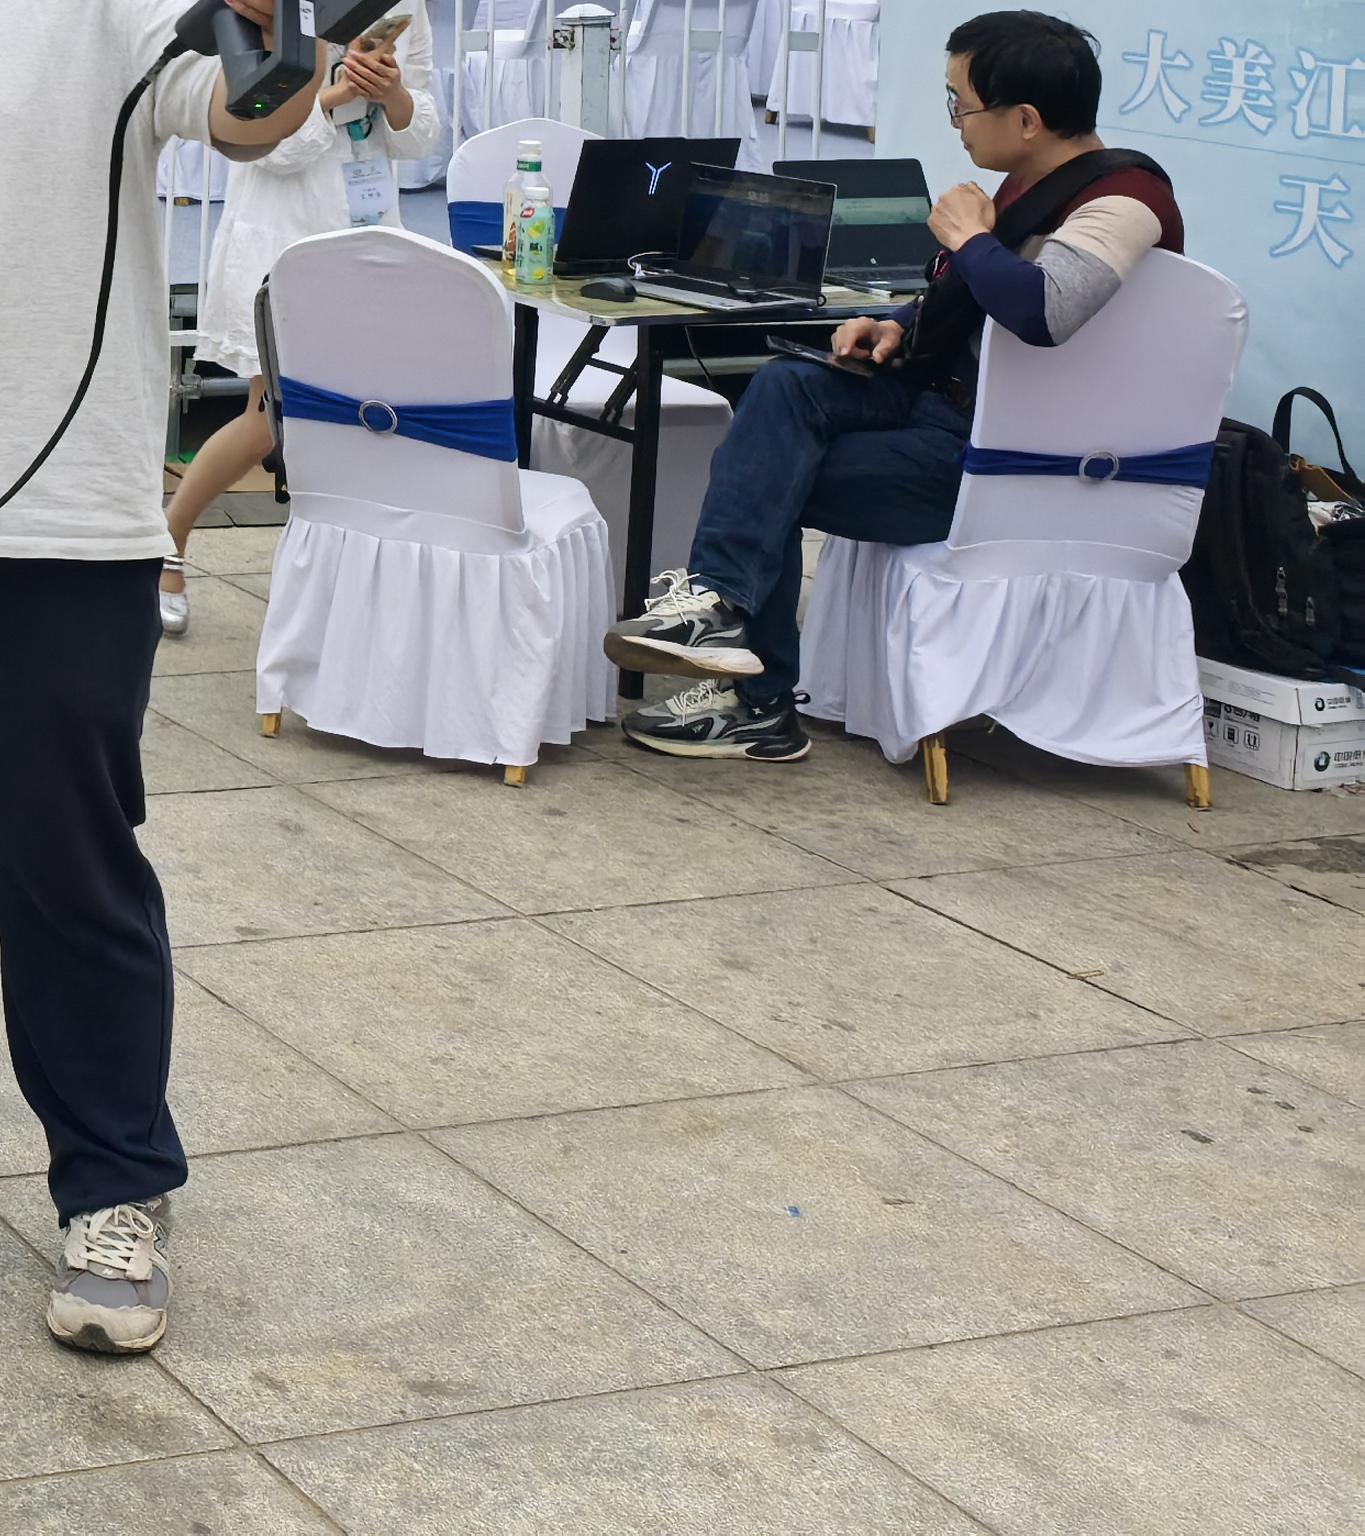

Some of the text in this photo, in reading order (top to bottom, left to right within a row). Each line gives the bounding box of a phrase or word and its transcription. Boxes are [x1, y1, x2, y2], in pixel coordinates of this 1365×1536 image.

[1119, 29, 1365, 140] 大美江
[1270, 173, 1355, 270] 天
